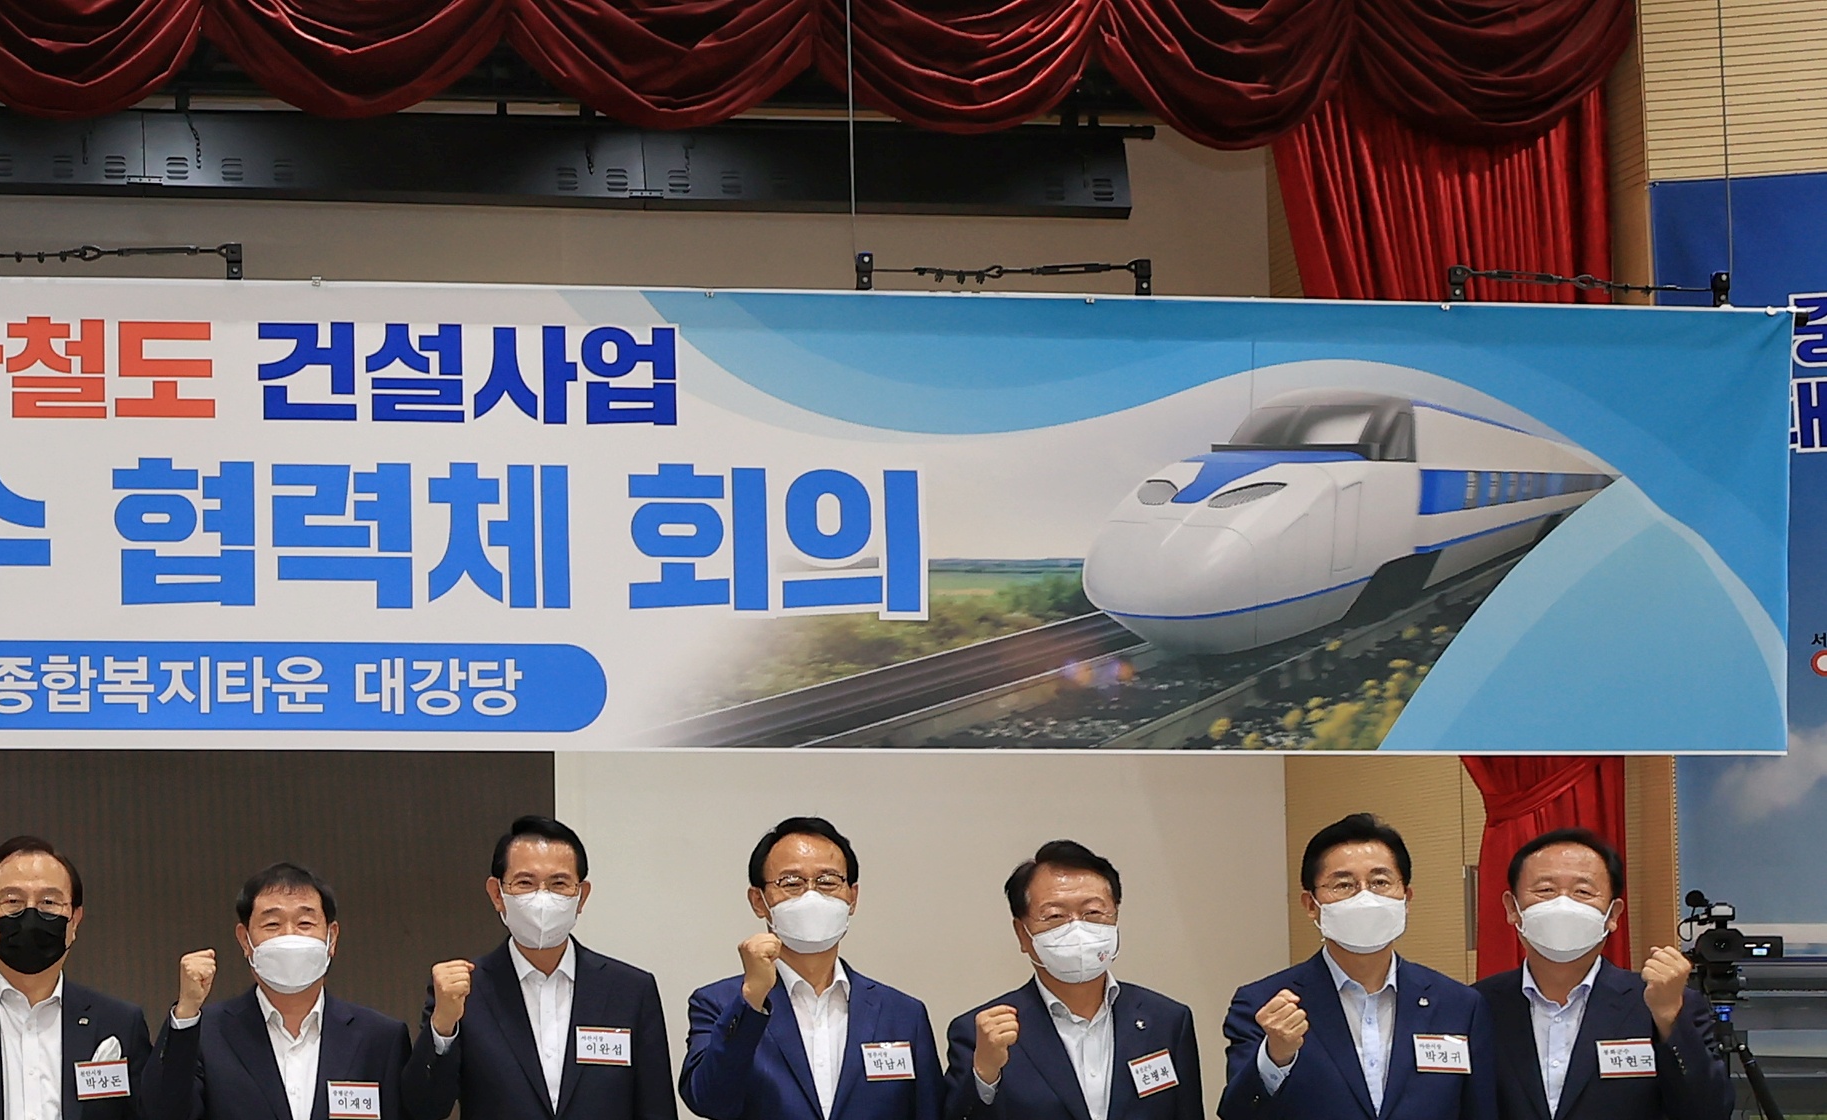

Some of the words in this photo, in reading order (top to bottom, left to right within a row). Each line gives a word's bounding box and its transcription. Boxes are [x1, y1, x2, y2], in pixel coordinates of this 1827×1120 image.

[260, 324, 677, 426] 건설사업
[114, 459, 571, 609] 협력체
[630, 465, 921, 612] 회의
[357, 659, 523, 716] 대강당
[586, 1043, 622, 1056] 이완섭
[872, 1057, 907, 1071] 박남서
[1424, 1050, 1462, 1064] 박경귀
[1610, 1055, 1653, 1068] 박현국
[85, 1076, 122, 1089] 박상돈
[1141, 1067, 1170, 1085] 손병복
[338, 1097, 372, 1110] 이재영
